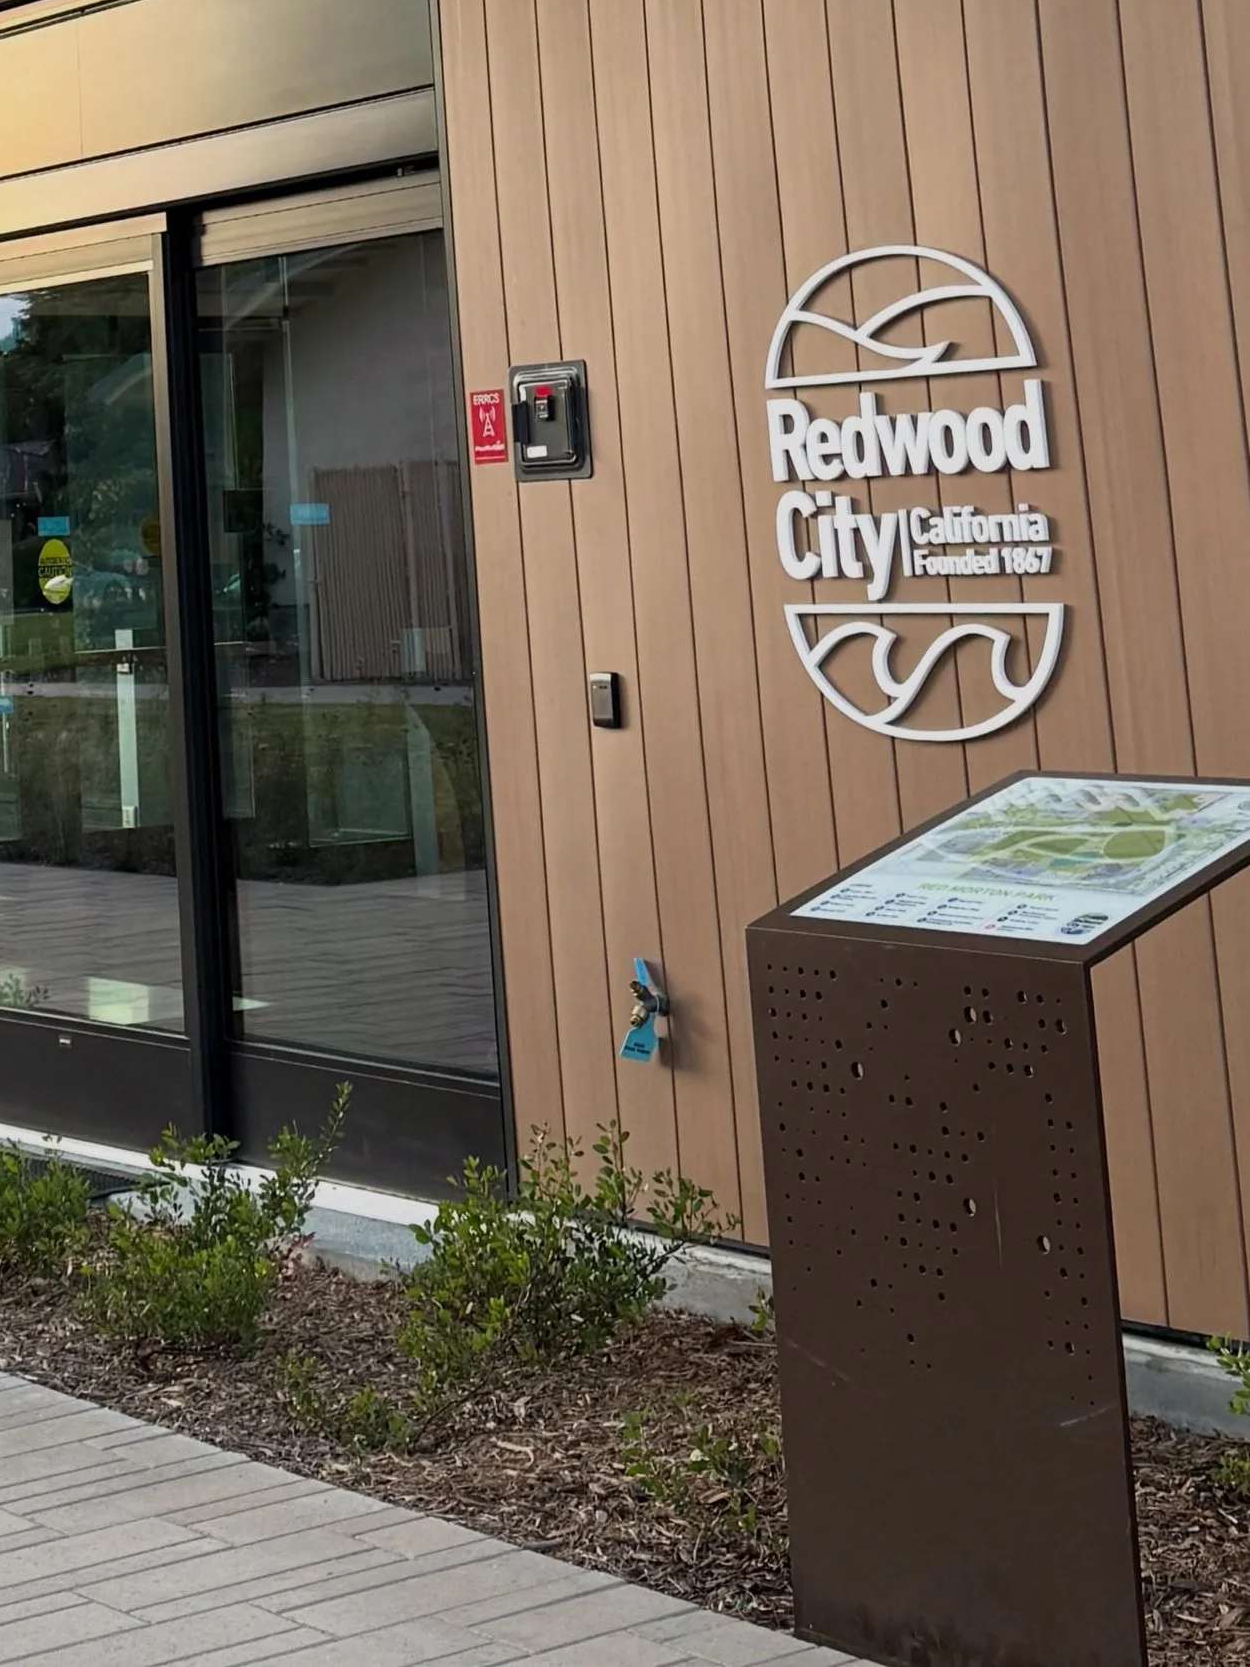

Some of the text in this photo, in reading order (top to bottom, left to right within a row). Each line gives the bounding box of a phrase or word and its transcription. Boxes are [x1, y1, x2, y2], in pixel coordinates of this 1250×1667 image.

[765, 378, 1051, 482] Redwood
[775, 489, 899, 602] City
[909, 502, 1050, 545] California
[912, 546, 1054, 576] Founded 1867
